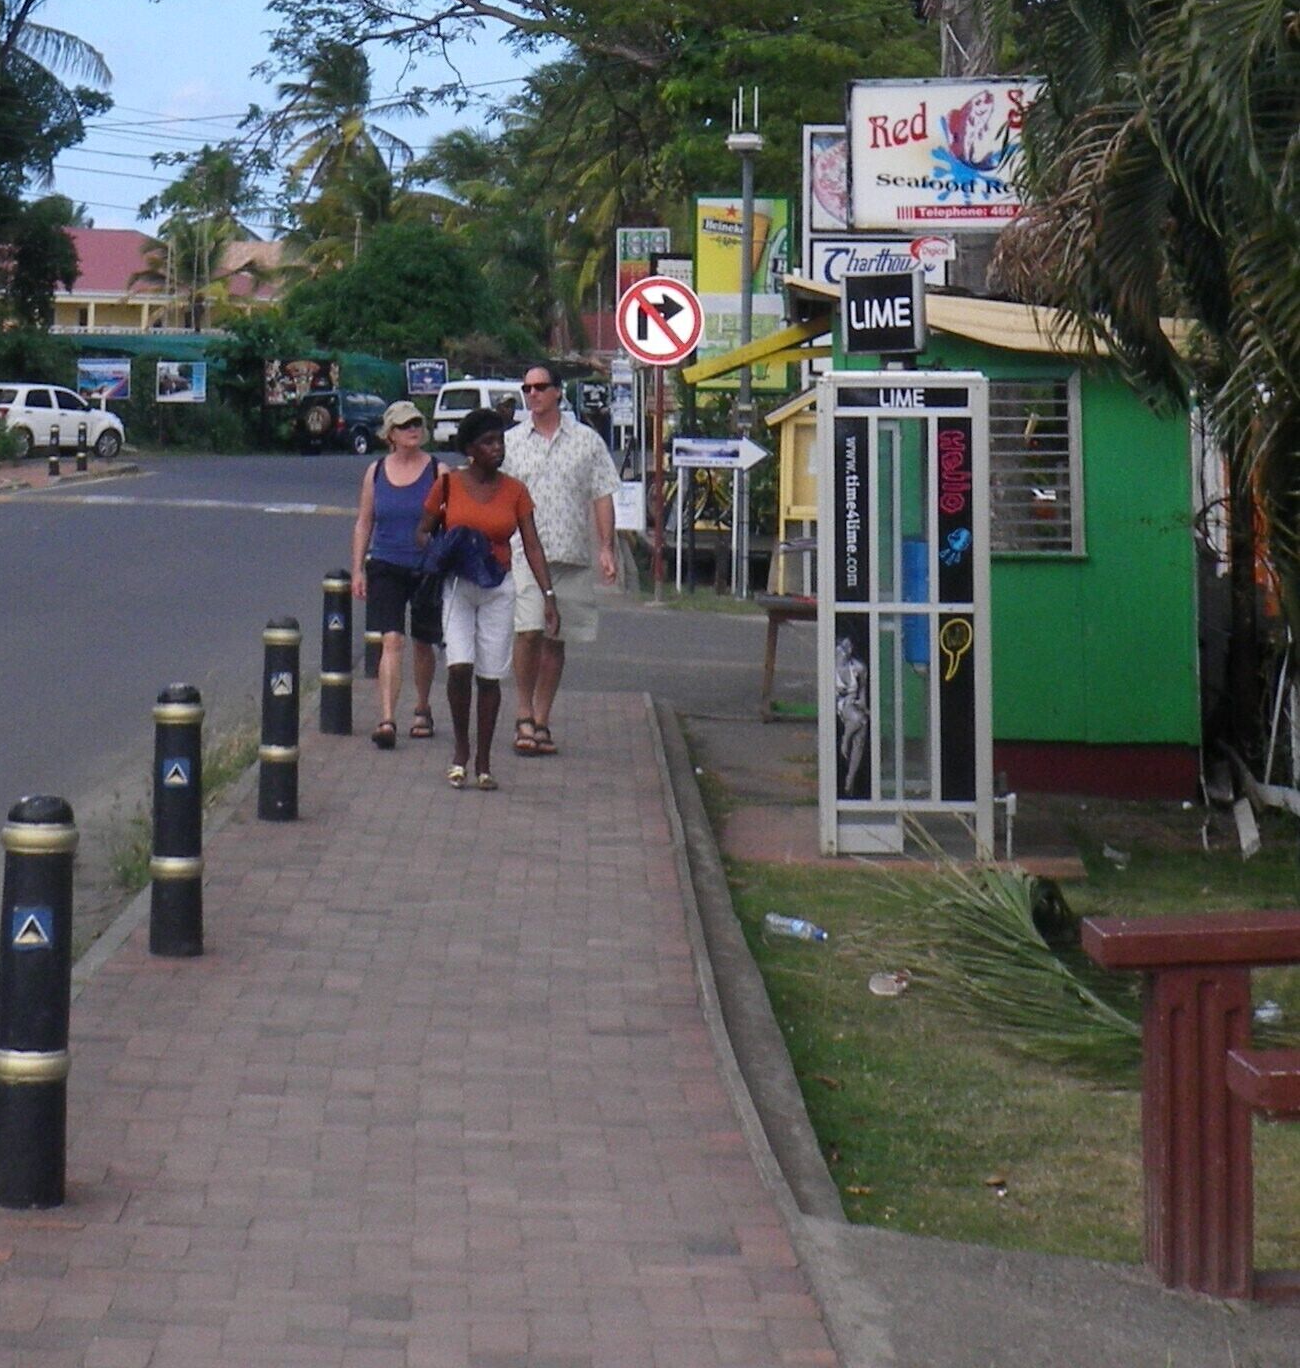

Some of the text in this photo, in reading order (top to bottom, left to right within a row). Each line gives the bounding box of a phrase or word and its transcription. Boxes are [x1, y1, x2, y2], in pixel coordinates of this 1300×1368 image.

[868, 102, 928, 149] Red
[876, 173, 975, 194] Seafood
[919, 206, 987, 220] Telephone:
[850, 296, 912, 331] LIME
[879, 388, 926, 407] LIME
[844, 435, 861, 587] www.time4lime.com
